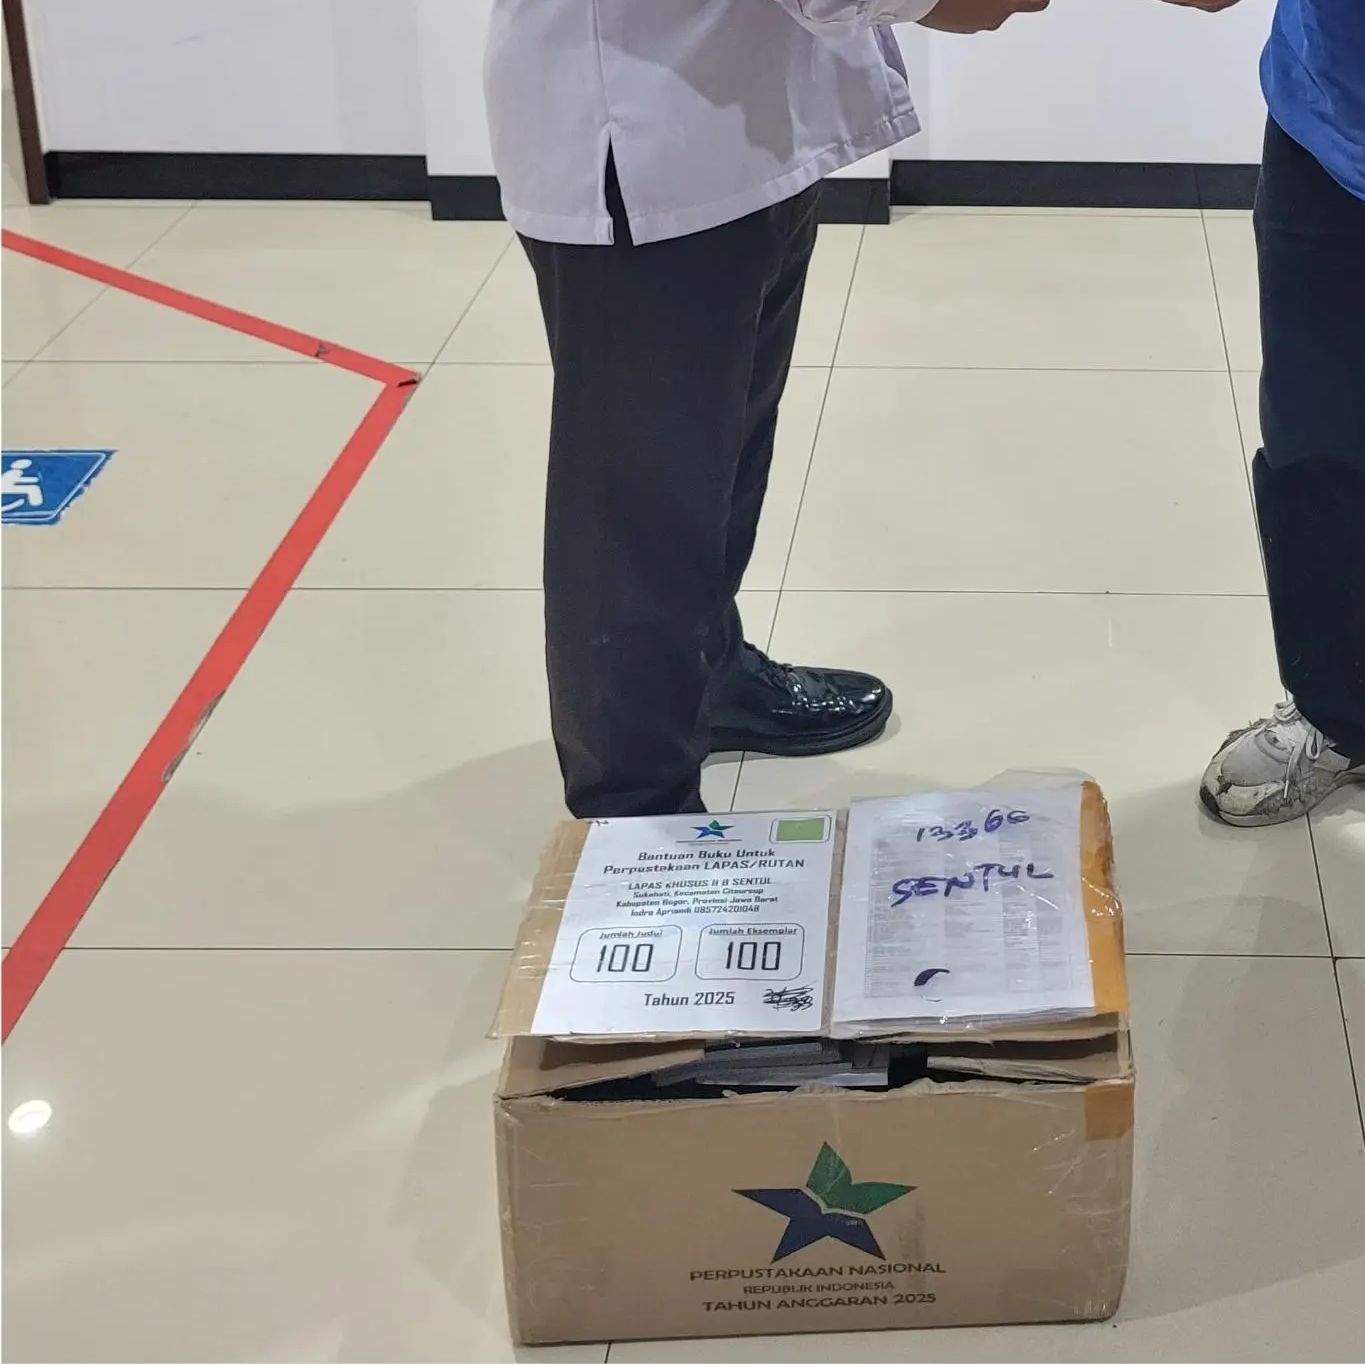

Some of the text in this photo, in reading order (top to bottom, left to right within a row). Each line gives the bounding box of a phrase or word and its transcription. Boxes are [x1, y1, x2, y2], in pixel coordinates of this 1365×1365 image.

[638, 848, 776, 861] Bantuan Buku Untuk
[603, 859, 805, 875] Perpustakaan LAPAS/RUTAN
[628, 881, 662, 890] LAPAS
[665, 880, 709, 889] KHUSUS
[732, 877, 773, 886] SENTUL
[890, 862, 1054, 908] SENTUL
[730, 896, 752, 904] Jawa
[754, 895, 778, 903] Barat
[708, 926, 798, 937] Jumlah Eksemplar
[596, 943, 654, 973] 100
[725, 941, 782, 971] 100
[644, 991, 735, 1007] Tahun 2025
[689, 1262, 947, 1282] PERPUSTAKAAN NASIONAL
[743, 1281, 895, 1295] REPUBLIK INDONESIA
[702, 1293, 937, 1312] TAHUN ANGGARAN 2025
